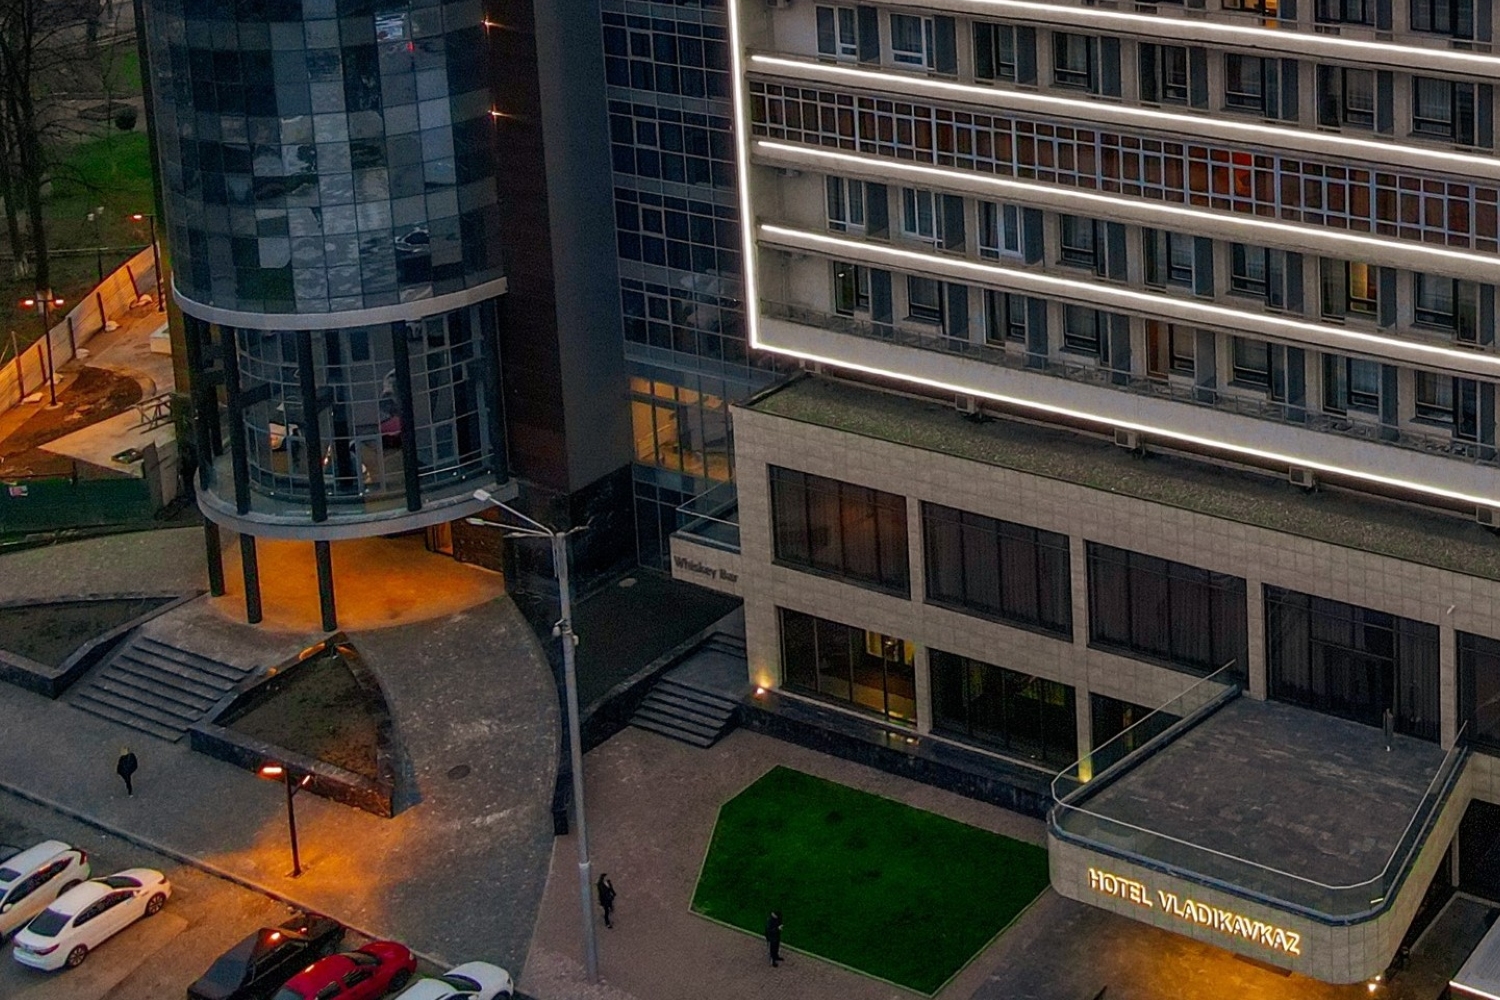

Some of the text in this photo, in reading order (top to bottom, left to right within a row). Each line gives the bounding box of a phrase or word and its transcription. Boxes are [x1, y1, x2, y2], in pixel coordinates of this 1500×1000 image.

[673, 555, 739, 583] Whiskey Bar
[1087, 867, 1301, 956] HOTEL VLADIKAVKAZ
